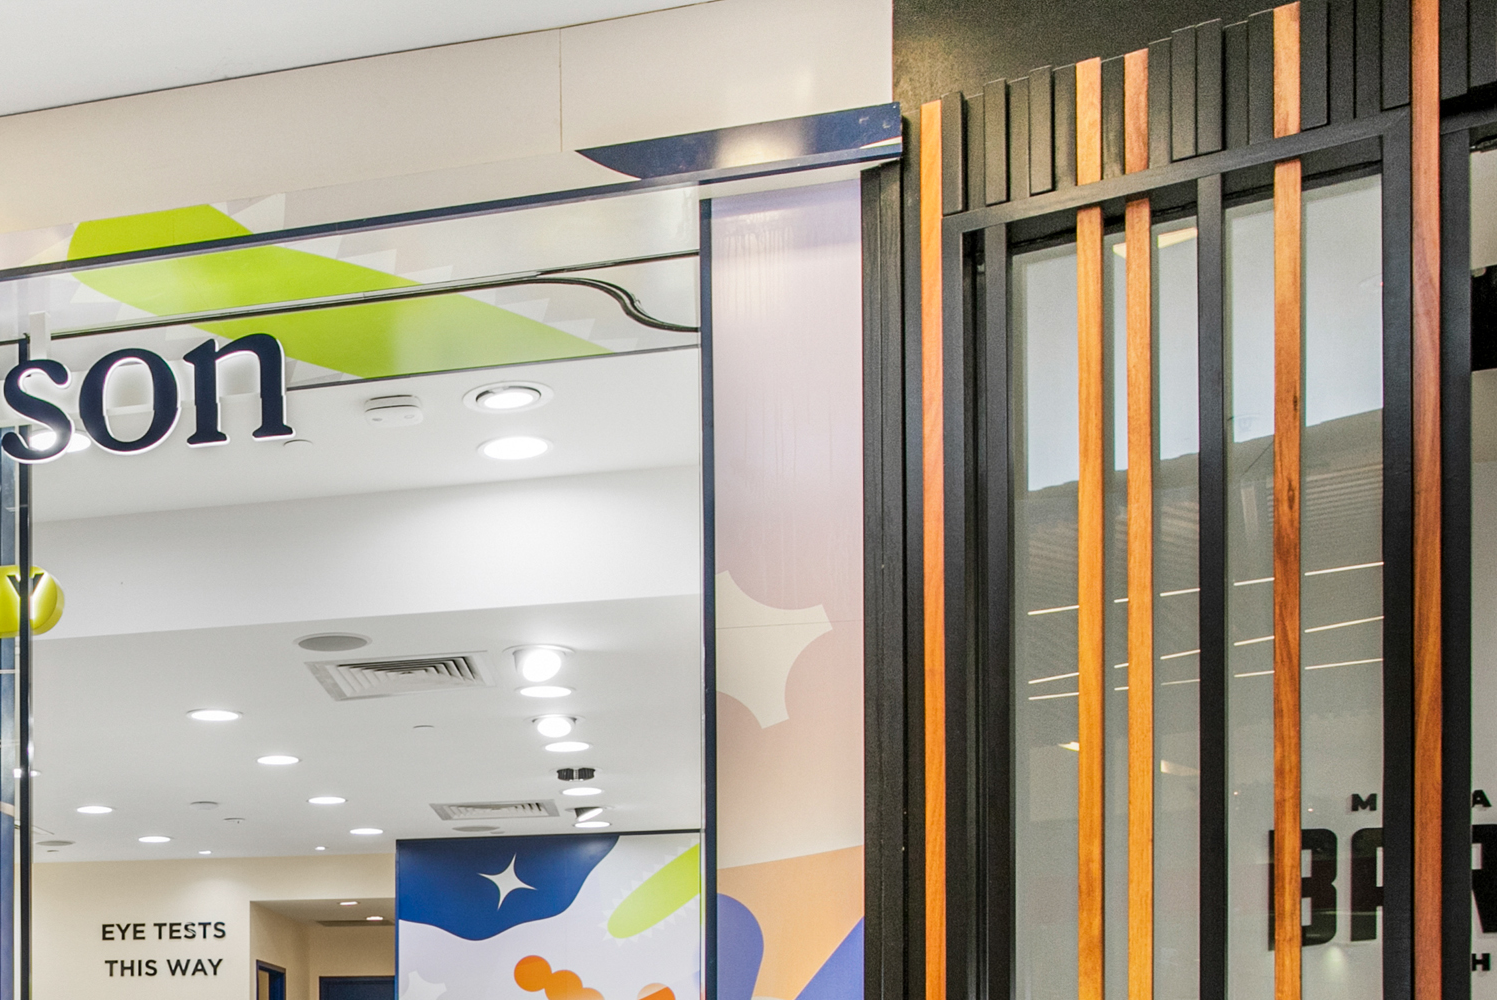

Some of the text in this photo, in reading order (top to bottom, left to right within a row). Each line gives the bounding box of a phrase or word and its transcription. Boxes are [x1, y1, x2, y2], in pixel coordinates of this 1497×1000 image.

[102, 921, 226, 940] EYE TESTS
[104, 958, 223, 977] THIS WAY
